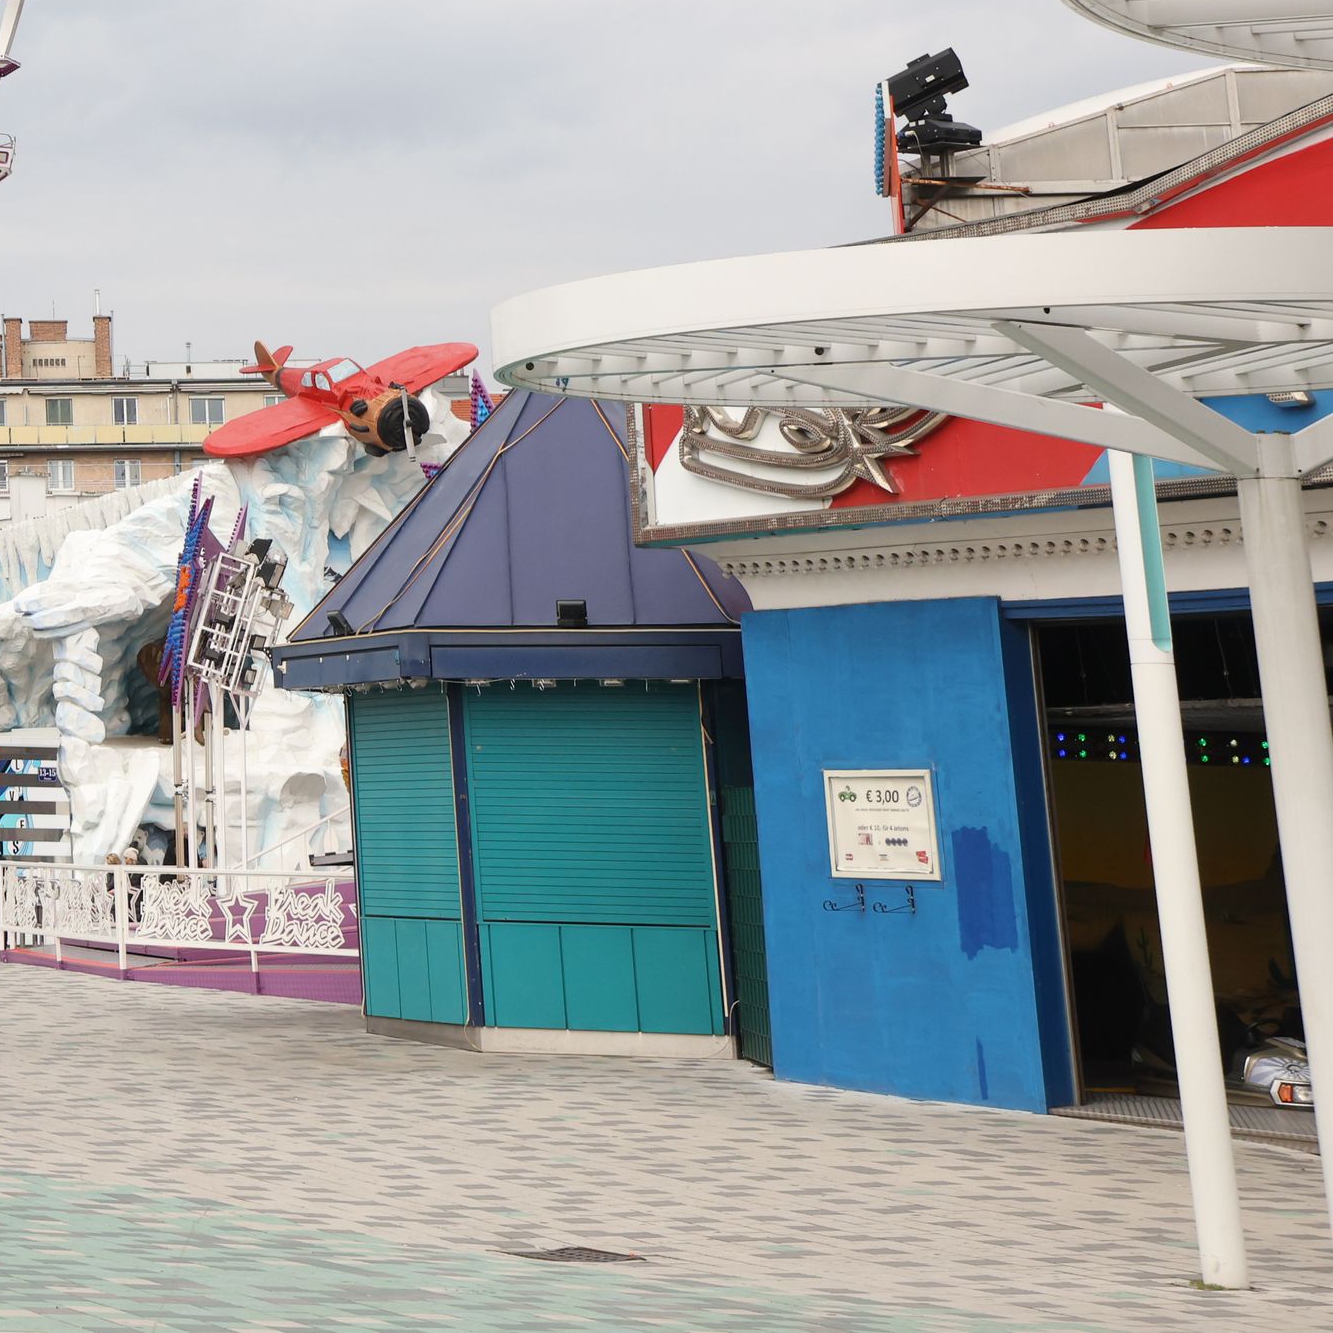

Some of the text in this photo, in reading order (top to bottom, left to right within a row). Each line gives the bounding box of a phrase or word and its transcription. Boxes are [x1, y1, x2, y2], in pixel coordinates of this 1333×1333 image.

[39, 768, 56, 777] 13-15
[866, 789, 873, 803] €
[875, 789, 899, 805] 3,00
[264, 877, 345, 925] Break
[136, 912, 213, 941] Dance
[259, 917, 345, 950] Dance
